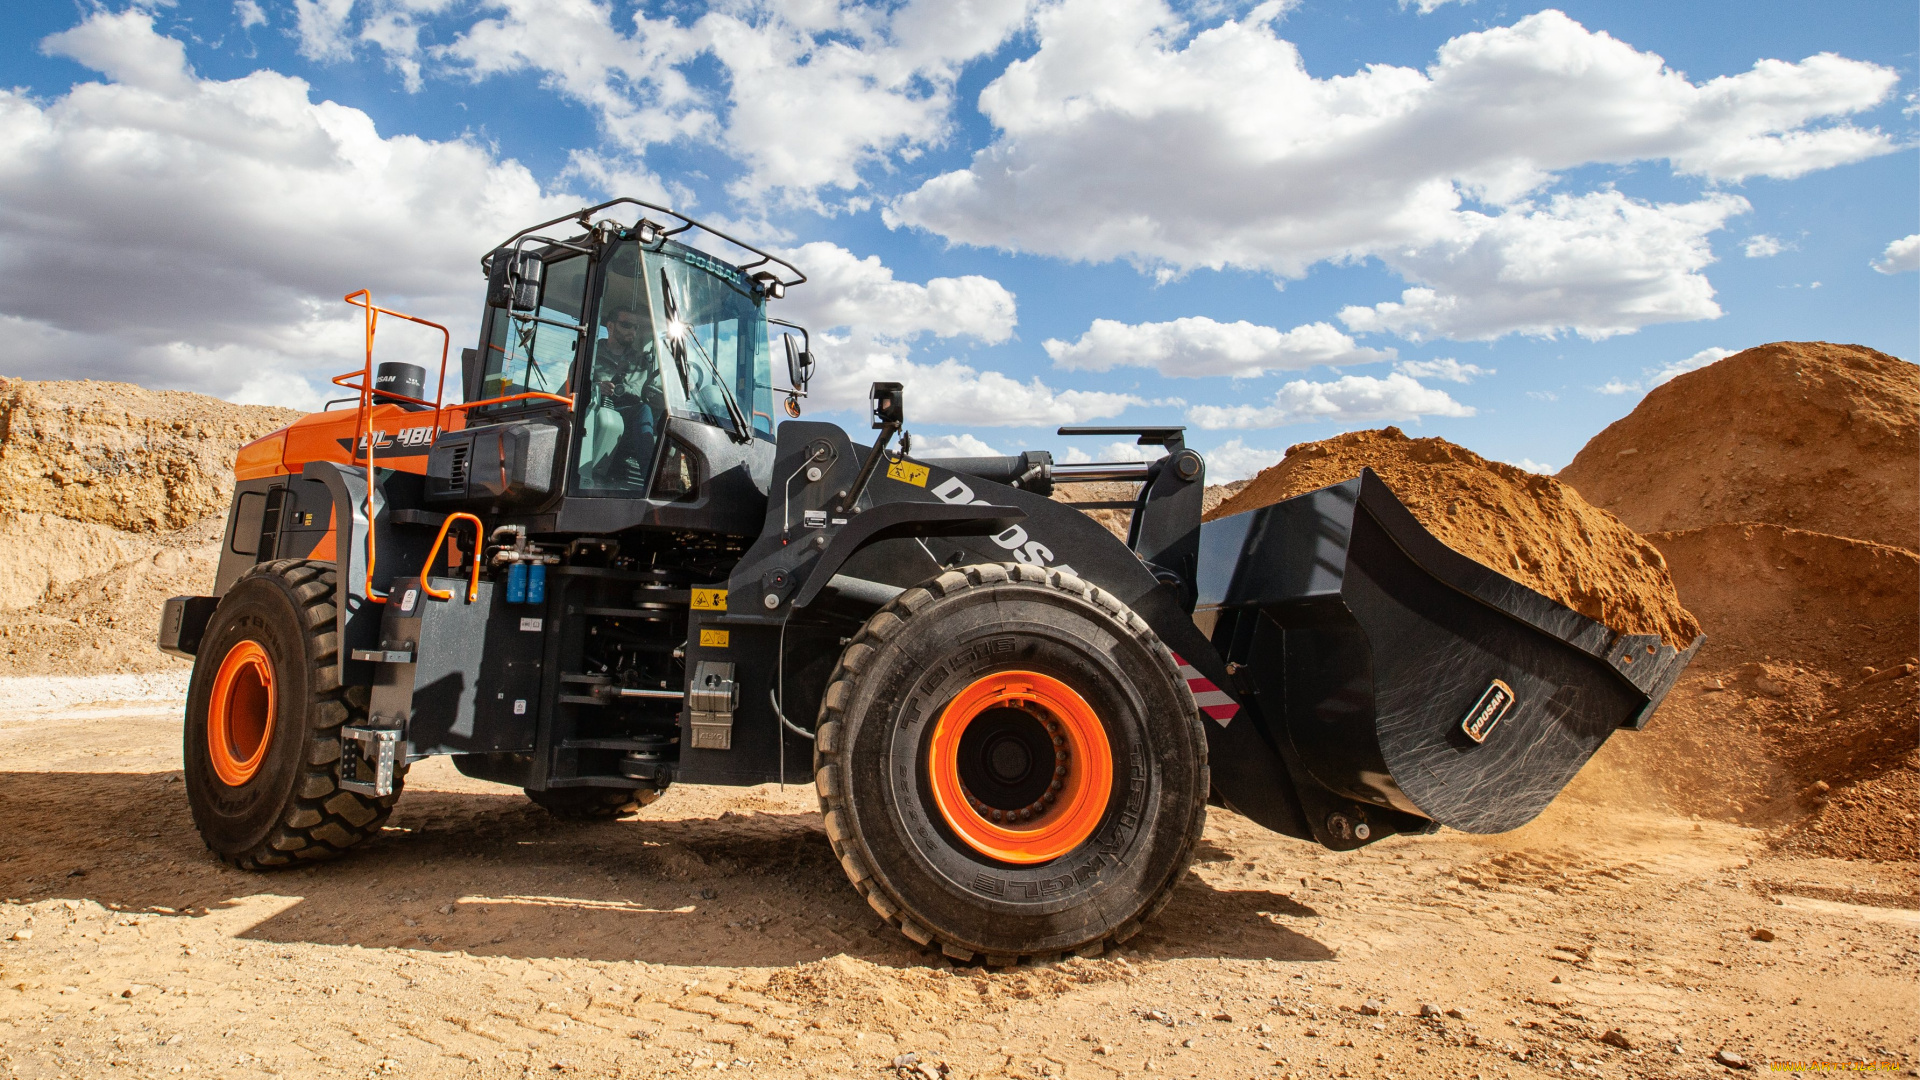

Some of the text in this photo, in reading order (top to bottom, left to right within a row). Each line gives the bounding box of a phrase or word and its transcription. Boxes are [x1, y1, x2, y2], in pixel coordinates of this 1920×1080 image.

[931, 476, 1079, 577] DOS
[1470, 690, 1505, 734] DOOSAN
[973, 743, 1147, 898] TRIANGLE
